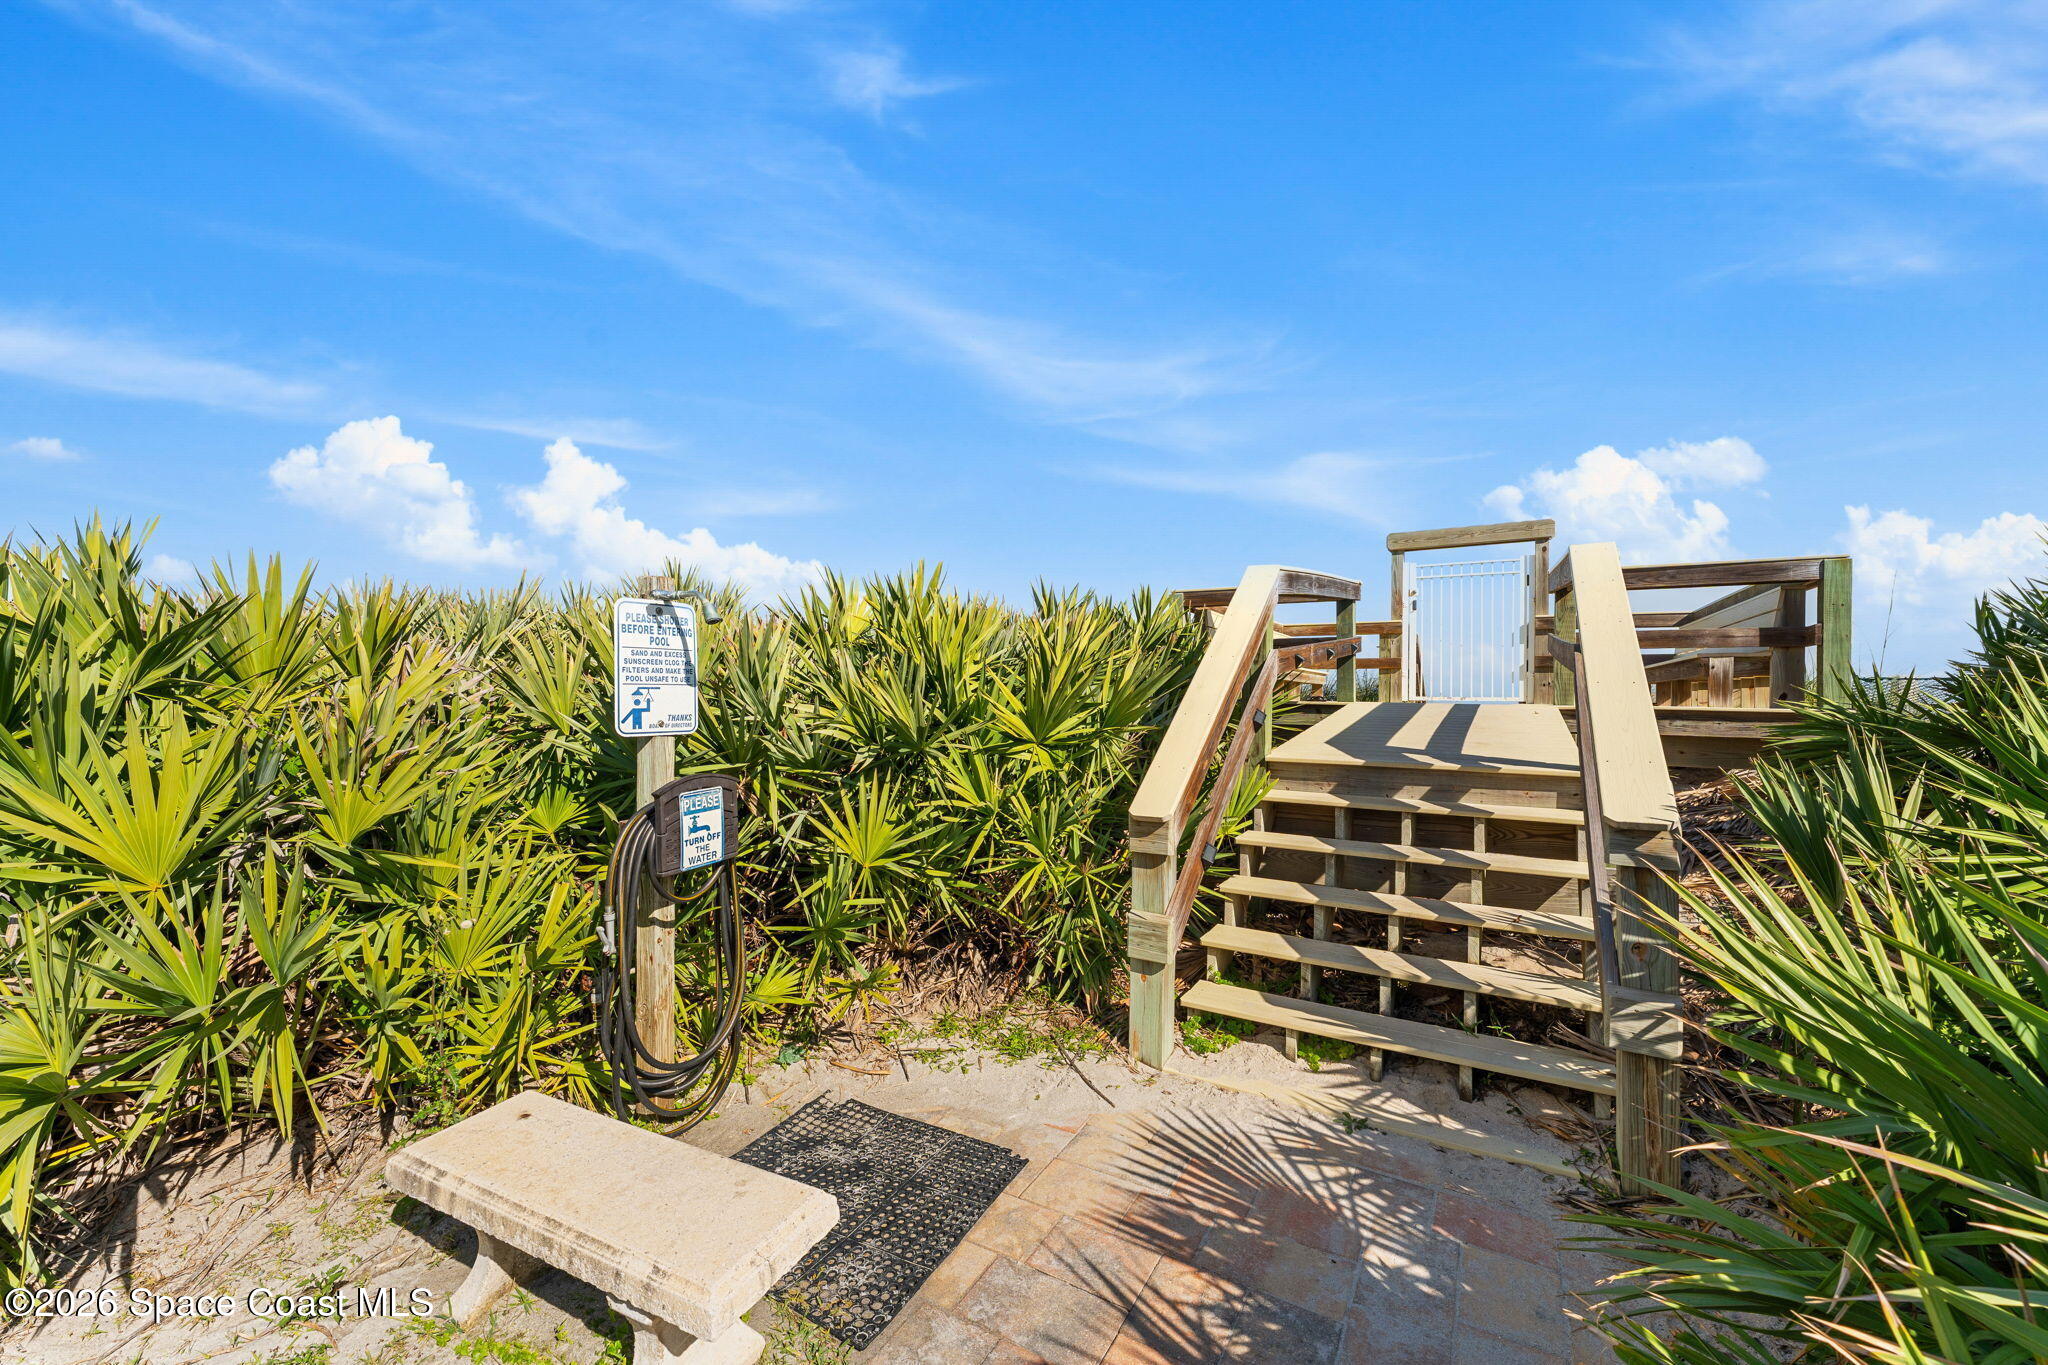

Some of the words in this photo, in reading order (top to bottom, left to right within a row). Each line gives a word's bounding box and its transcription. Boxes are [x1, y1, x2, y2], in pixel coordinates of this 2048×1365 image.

[625, 612, 657, 624] PLEASE
[659, 614, 688, 627] SHOWER
[621, 623, 655, 635] BEFORE
[657, 626, 693, 638] ENTERING
[649, 636, 670, 647] POOL
[623, 658, 663, 666] SUNSCREEN
[621, 666, 649, 674] FILTERS
[665, 667, 681, 675] MAKE
[667, 714, 693, 722] THANKS
[684, 794, 720, 812] PLEASE
[684, 836, 705, 847] TURN
[707, 832, 721, 840] OFF
[695, 843, 710, 854] THE
[688, 850, 717, 865] WATER
